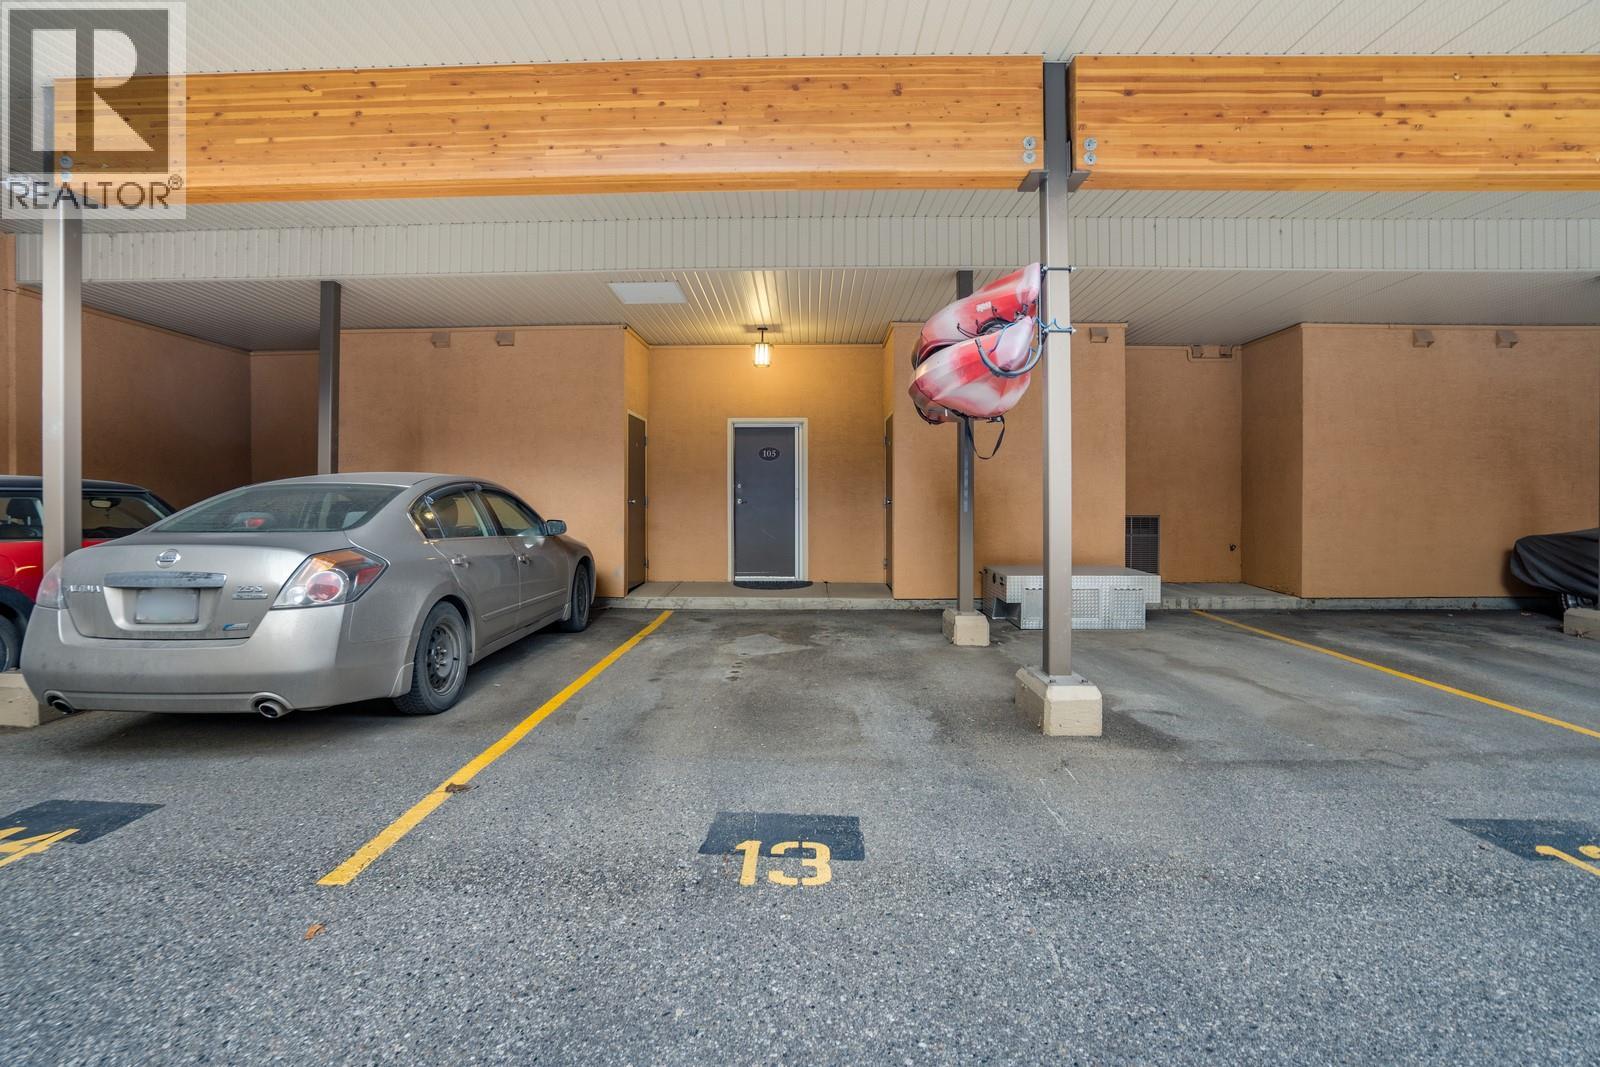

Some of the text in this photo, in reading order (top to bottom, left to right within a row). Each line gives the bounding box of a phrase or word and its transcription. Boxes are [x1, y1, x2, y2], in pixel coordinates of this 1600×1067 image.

[762, 449, 777, 458] 105
[735, 840, 833, 886] 13
[1535, 845, 1600, 877] 1
